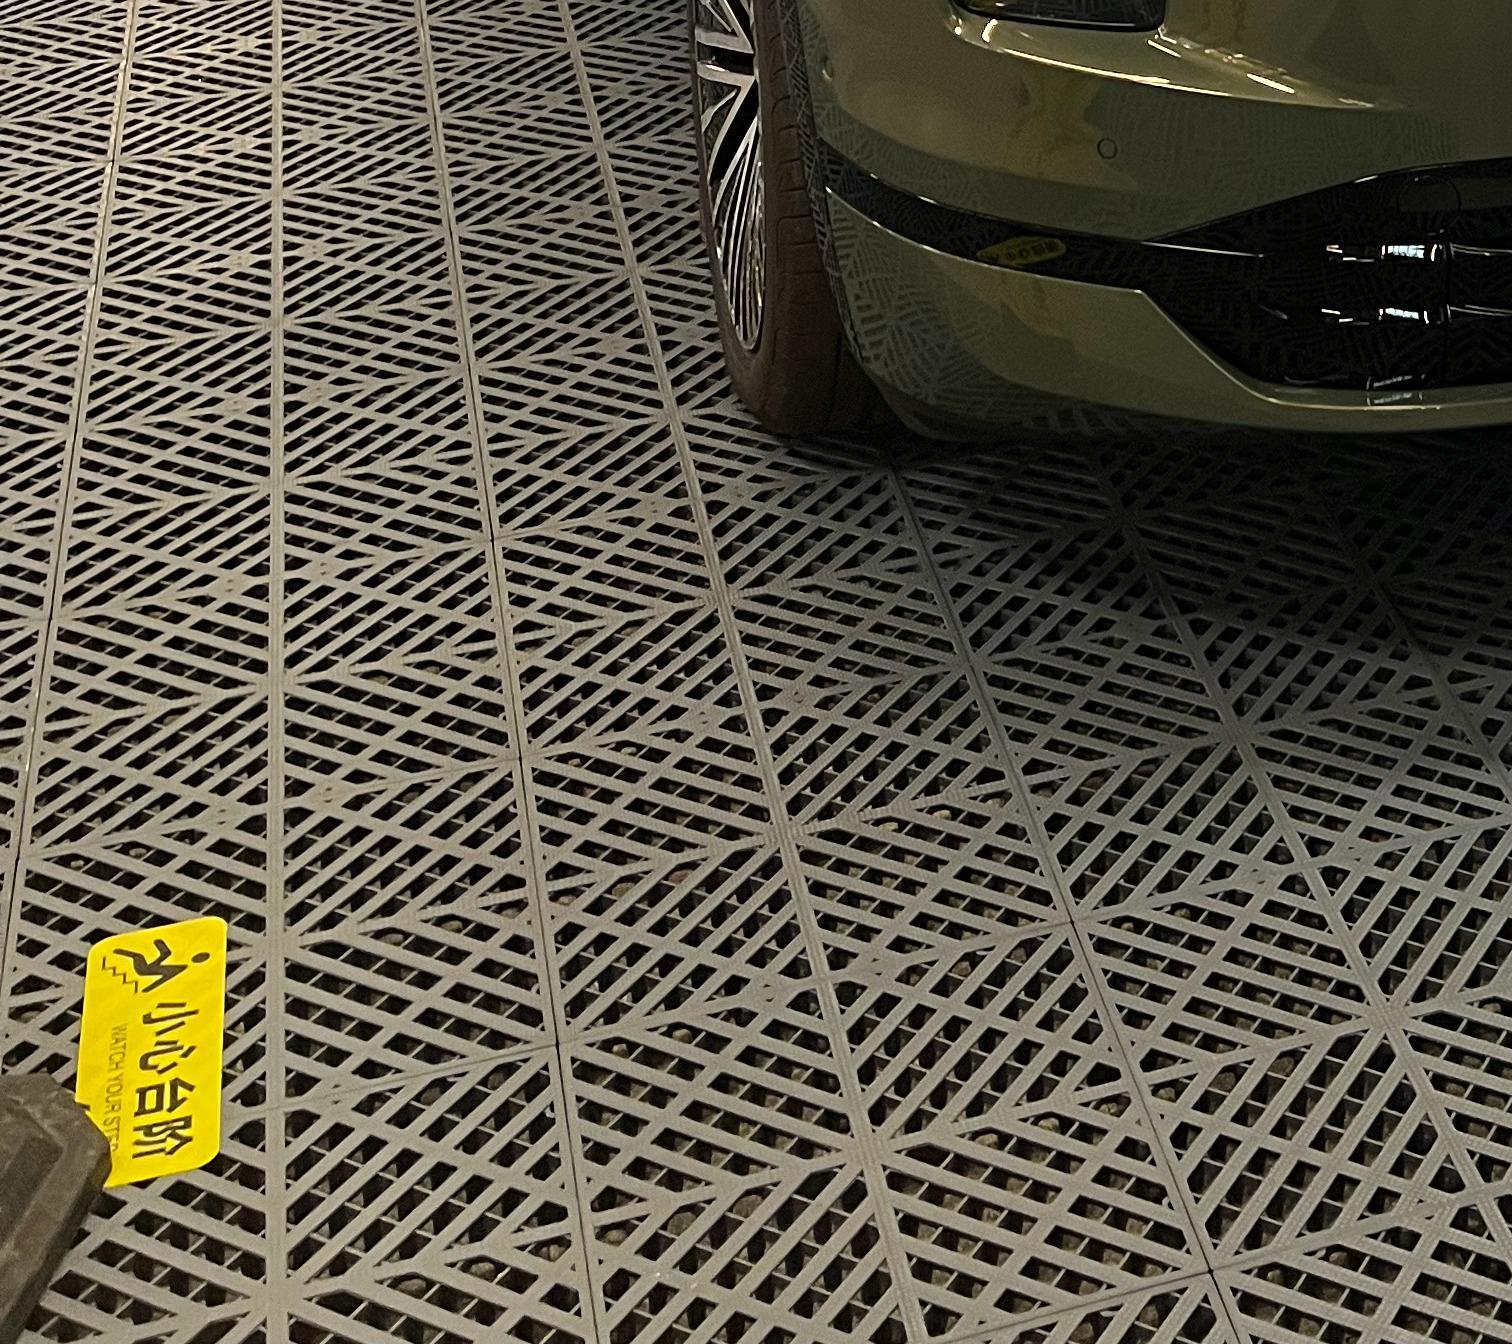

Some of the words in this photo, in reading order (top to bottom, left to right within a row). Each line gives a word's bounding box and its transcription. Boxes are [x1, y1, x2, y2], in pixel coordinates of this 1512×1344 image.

[108, 1023, 128, 1072] WATCH
[103, 1074, 124, 1114] YOUR
[131, 1002, 199, 1160] 小心台阶
